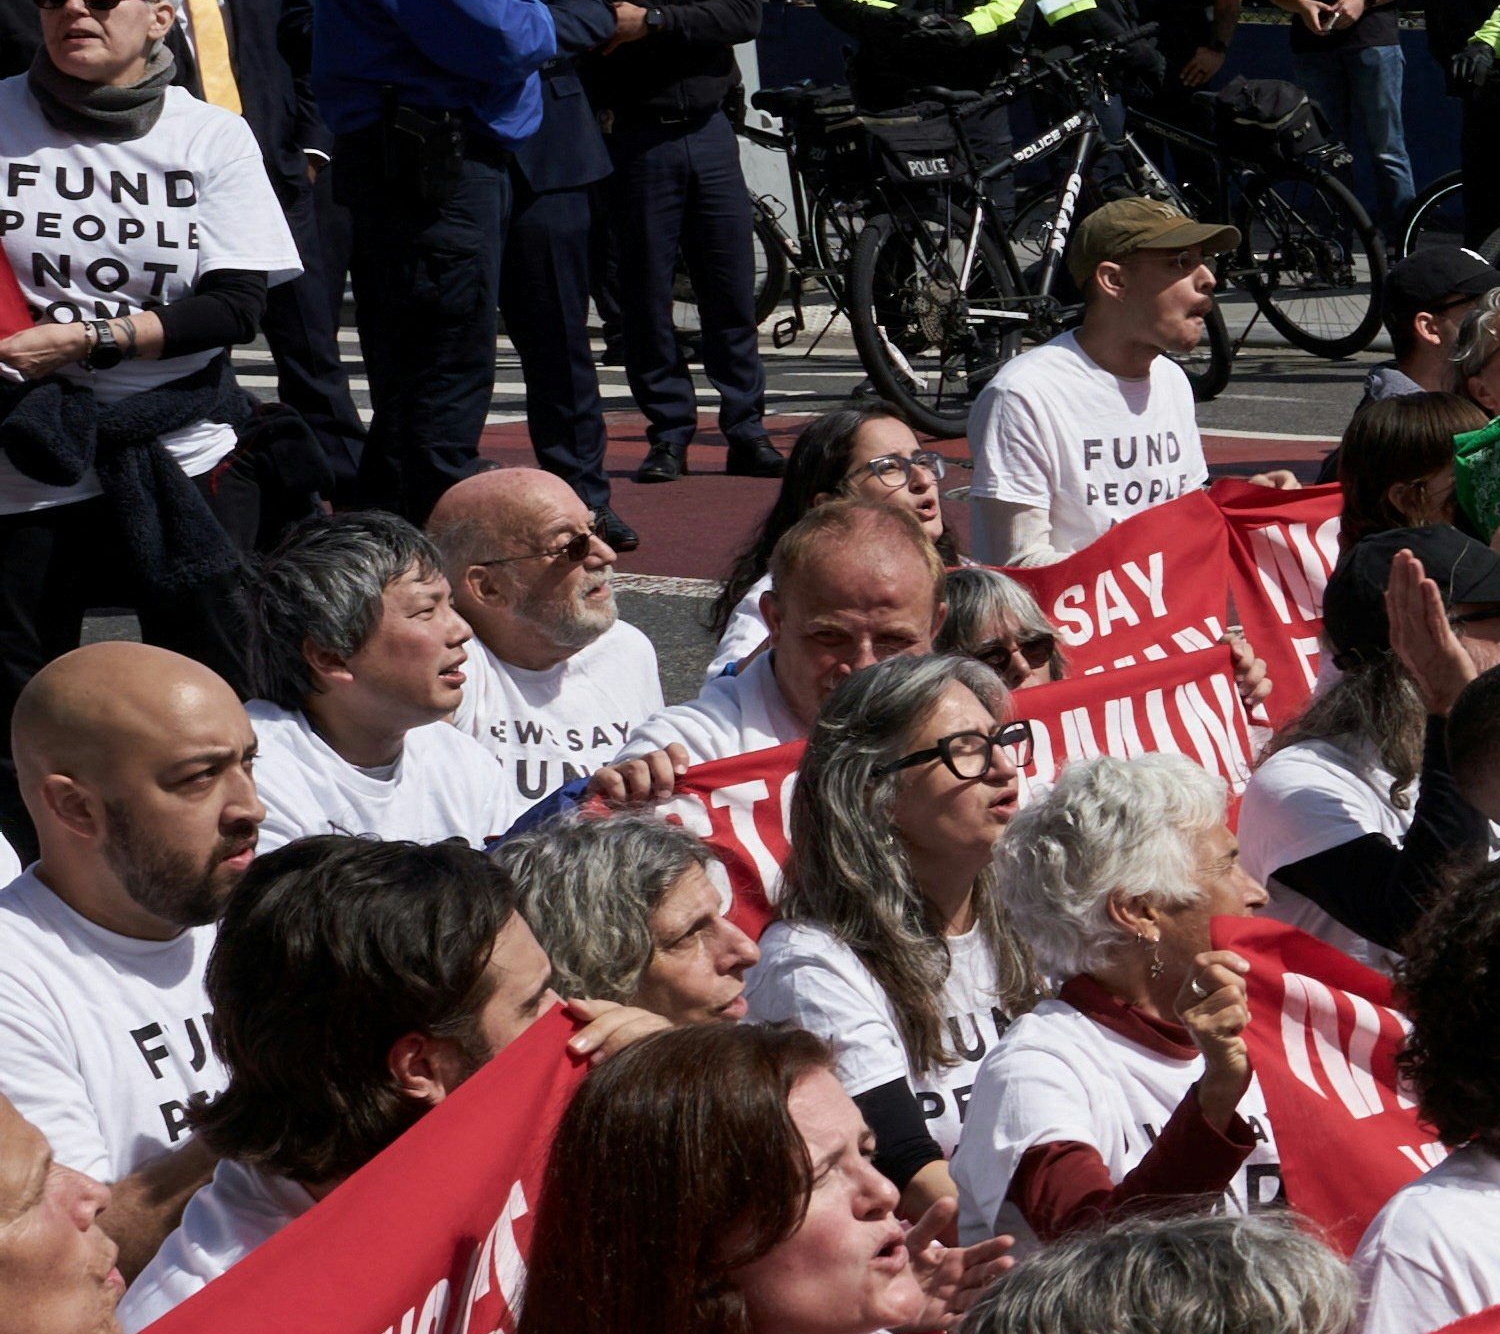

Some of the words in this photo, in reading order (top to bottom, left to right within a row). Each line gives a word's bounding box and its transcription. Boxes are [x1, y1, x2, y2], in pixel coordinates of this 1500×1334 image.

[1013, 128, 1062, 163] POLICE
[6, 164, 197, 208] FUND
[907, 158, 951, 178] POLICE
[0, 210, 200, 250] PEOPLE
[1051, 173, 1081, 256] NYPD
[32, 252, 178, 293] NOT
[1084, 431, 1181, 471] FUND
[1051, 551, 1168, 647] SAY
[567, 719, 632, 750] SAY
